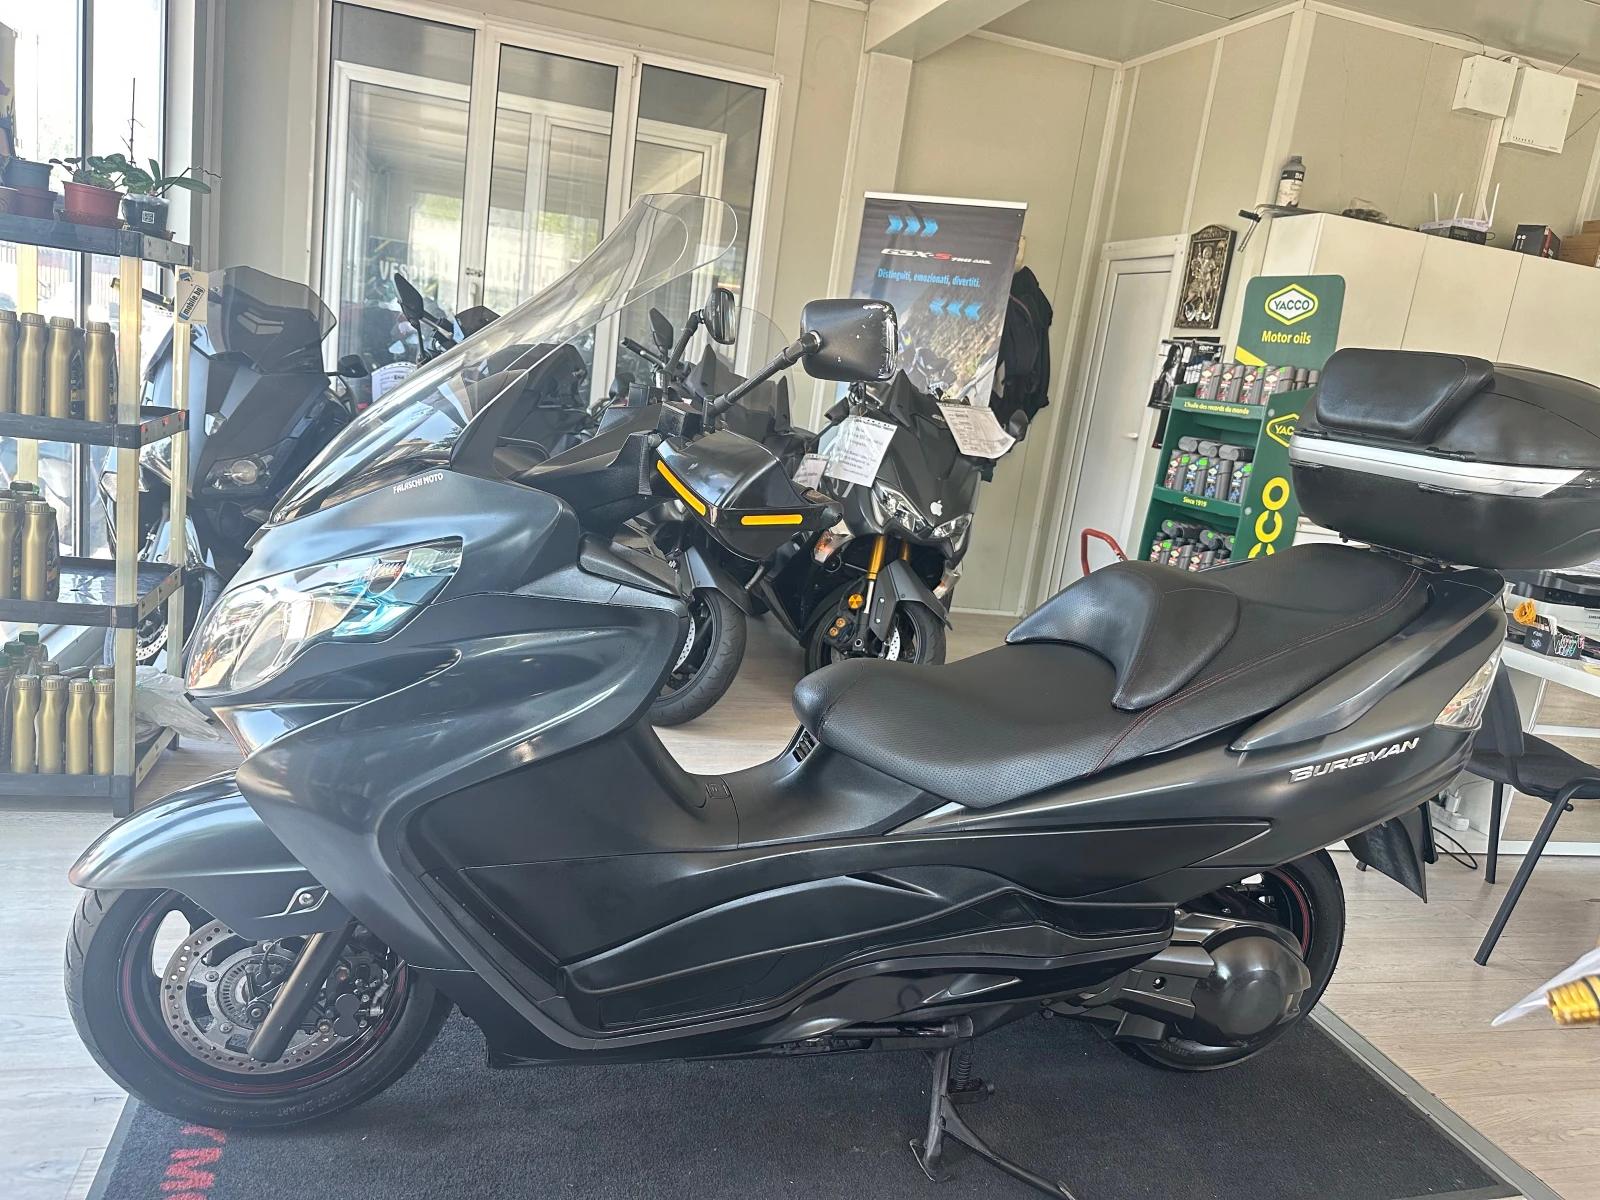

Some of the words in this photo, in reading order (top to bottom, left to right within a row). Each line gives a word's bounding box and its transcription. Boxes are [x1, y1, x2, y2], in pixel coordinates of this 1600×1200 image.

[878, 268, 912, 282] Distinguiti,
[913, 272, 951, 286] emozionati,
[952, 275, 980, 287] divertiti.
[183, 287, 204, 315] mobile.bg
[1274, 300, 1310, 310] YACCO
[1261, 330, 1292, 343] Motor
[1293, 331, 1311, 344] oils
[1184, 401, 1199, 409] L'huile
[1232, 406, 1250, 415] monde
[392, 477, 423, 494] FALASCHI
[423, 472, 444, 485] MOTO
[1183, 496, 1195, 505] Since
[1195, 498, 1207, 507] 1919
[1288, 737, 1420, 784] BURGMAN
